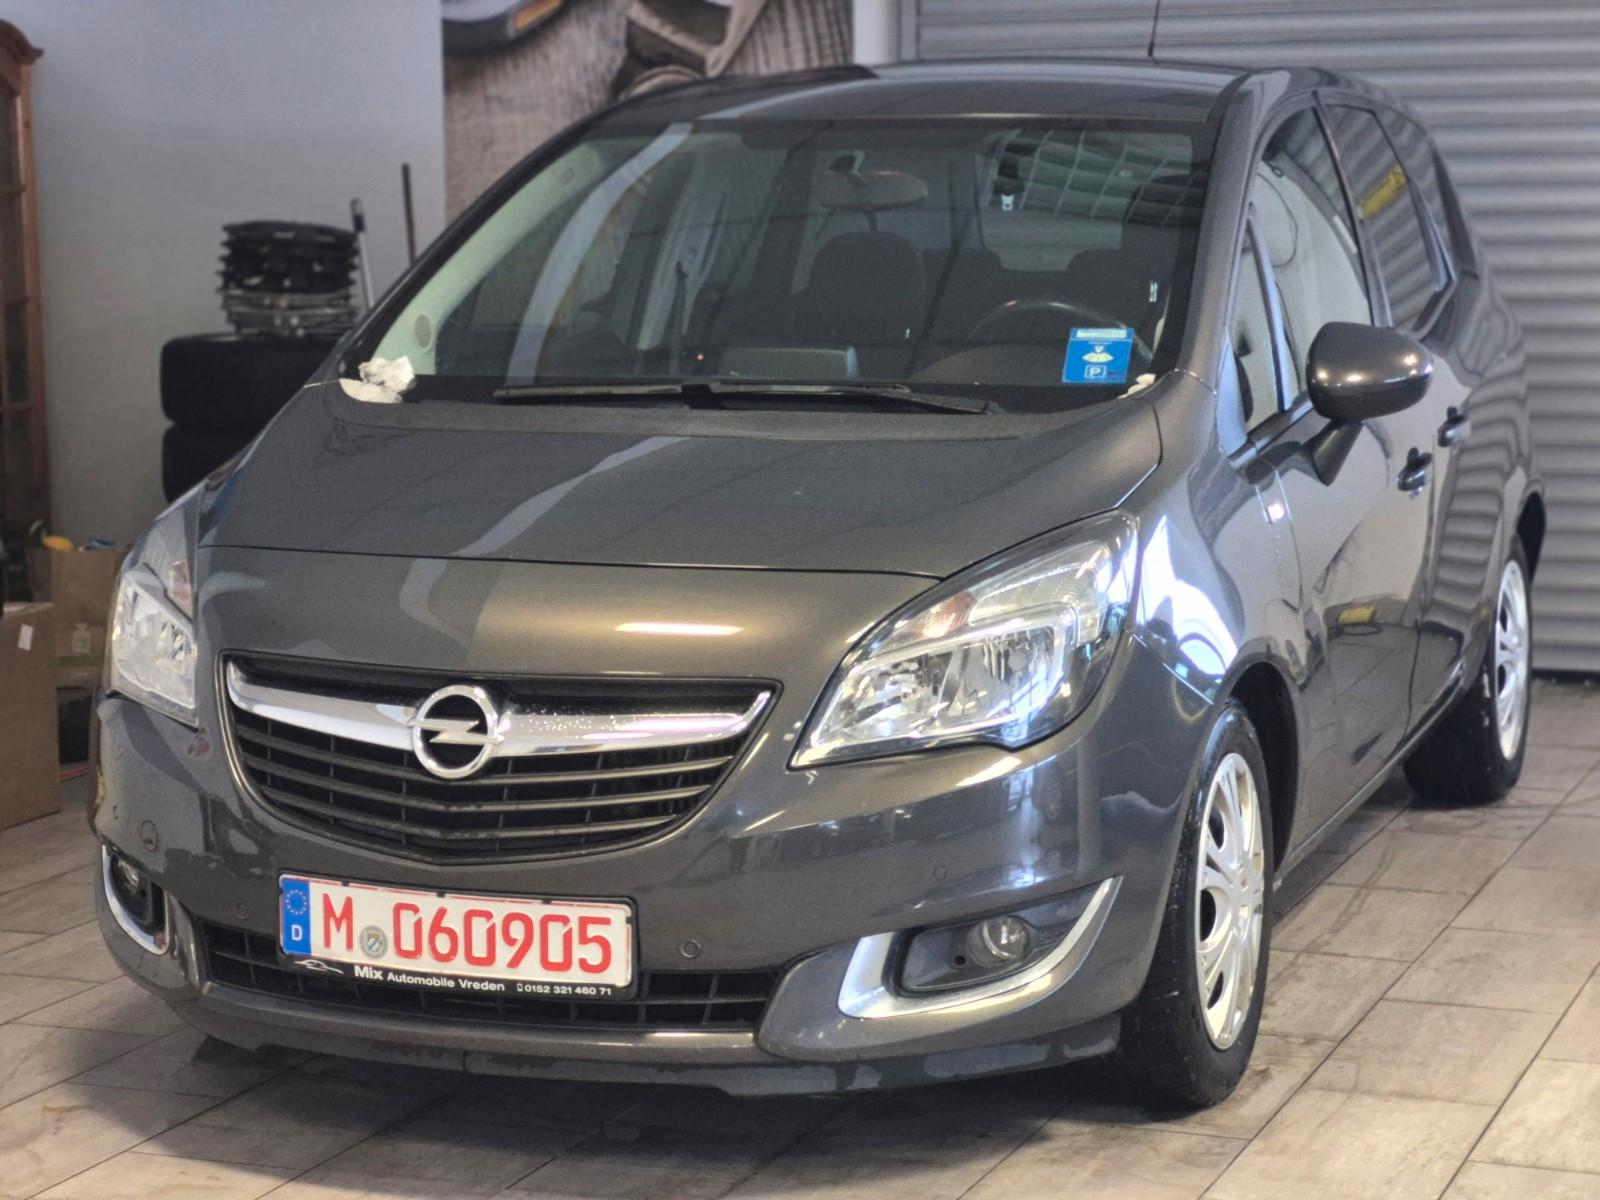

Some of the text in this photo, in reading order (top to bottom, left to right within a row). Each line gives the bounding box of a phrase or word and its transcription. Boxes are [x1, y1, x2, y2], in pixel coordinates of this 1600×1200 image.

[1090, 367, 1101, 376] P
[292, 925, 302, 941] D
[322, 893, 612, 974] M 060905
[354, 965, 384, 980] Mix
[387, 972, 455, 988] Automobile
[458, 979, 505, 991] Vreden
[524, 984, 551, 993] 0152
[553, 985, 572, 994] 321
[599, 987, 612, 996] 71
